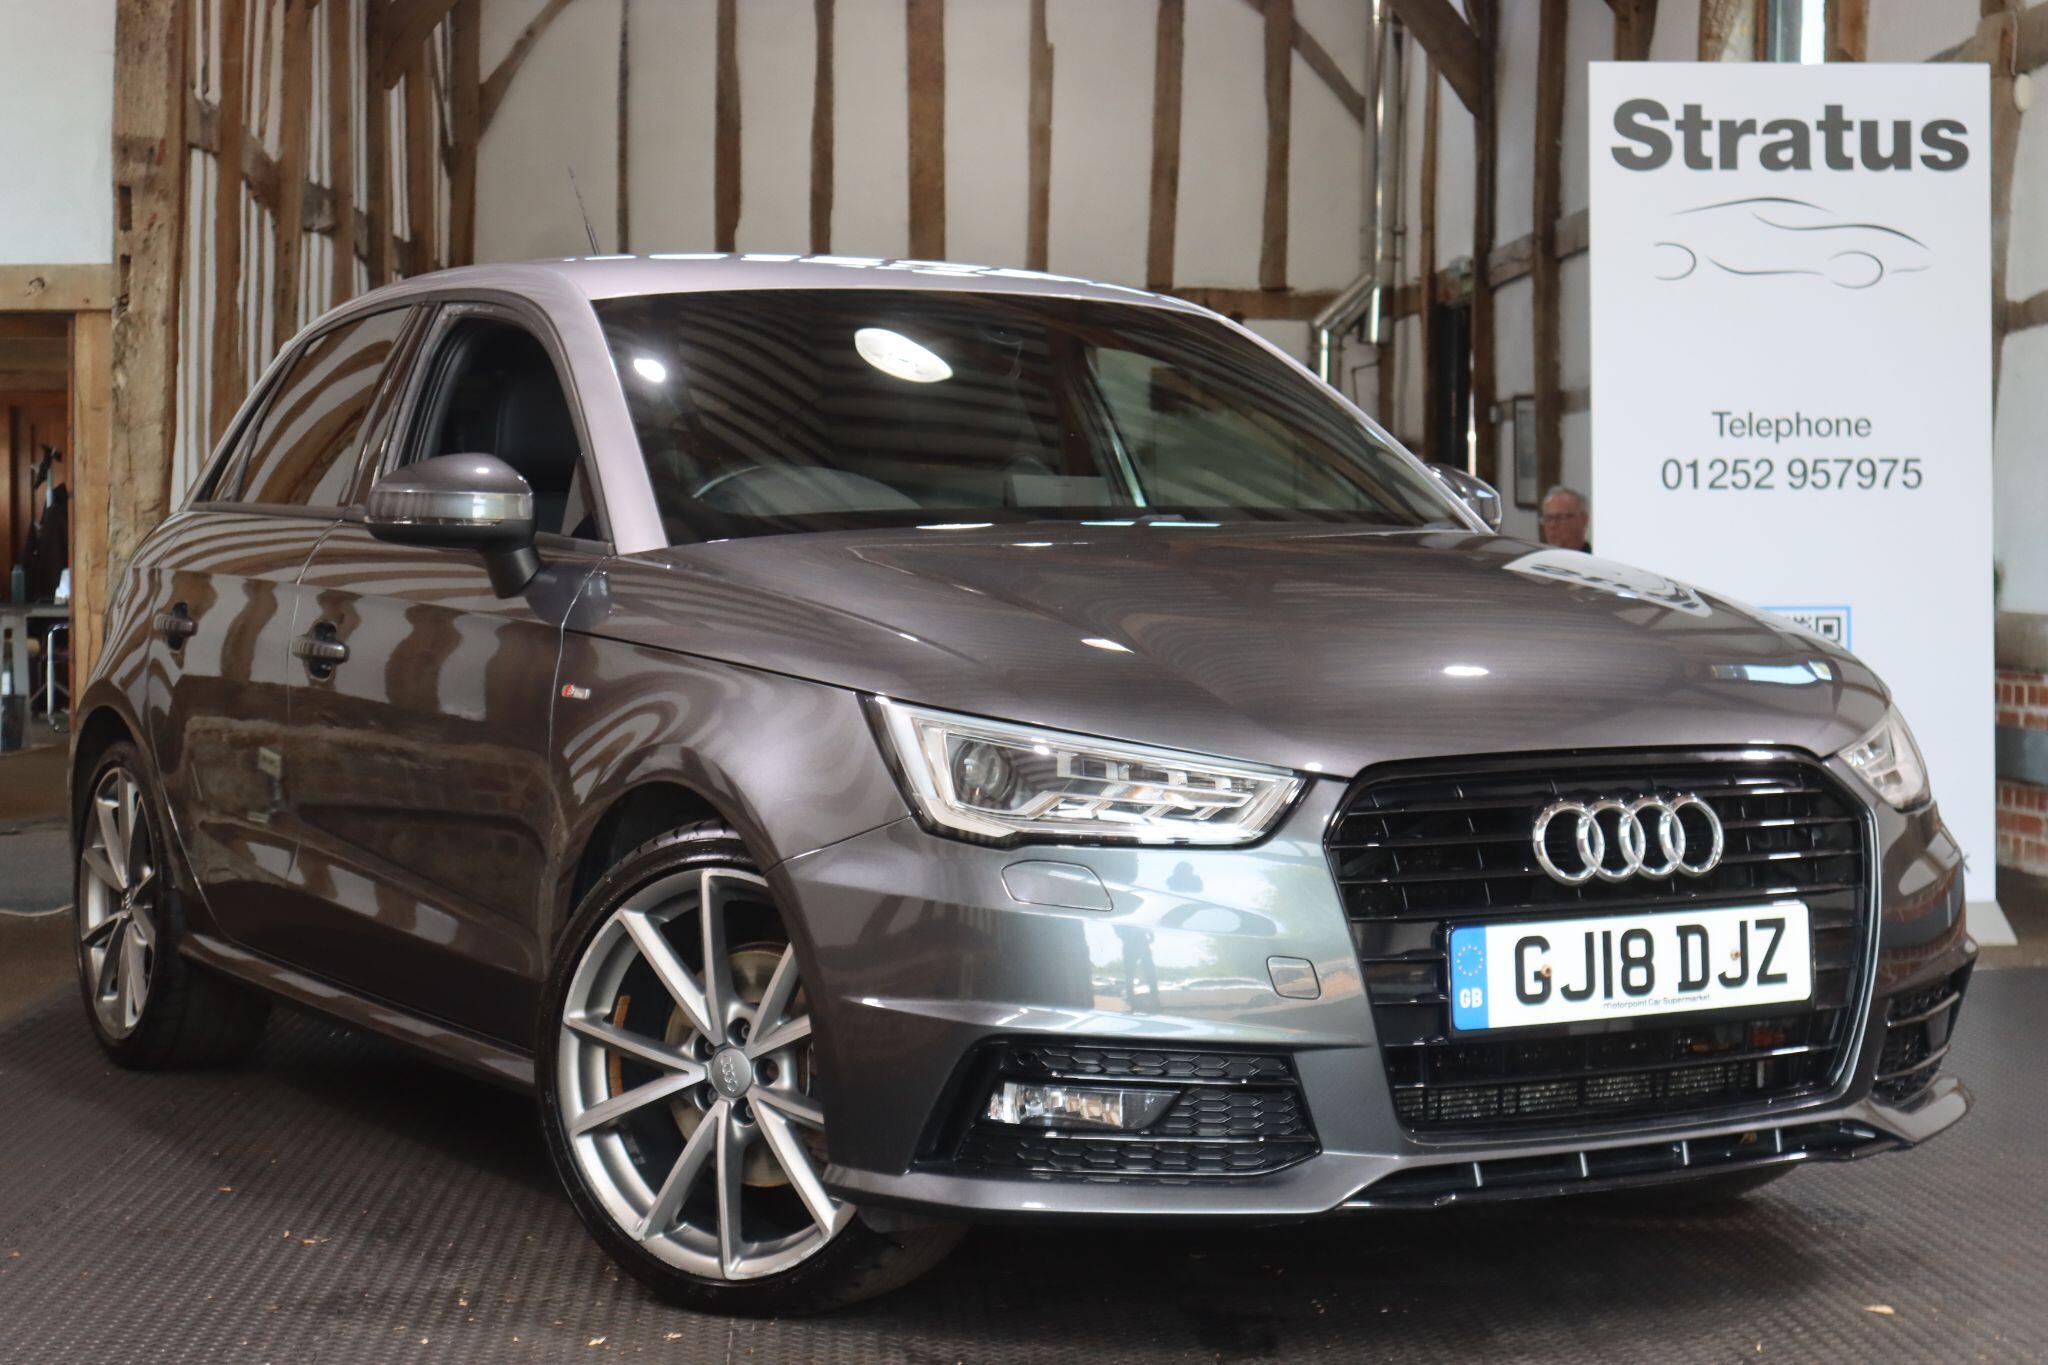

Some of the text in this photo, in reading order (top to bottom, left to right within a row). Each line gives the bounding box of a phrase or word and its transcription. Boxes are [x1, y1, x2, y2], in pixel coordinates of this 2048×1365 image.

[1610, 98, 1970, 172] Stratus
[1711, 411, 1873, 443] Telephone
[1661, 457, 1923, 491] 01252 957975
[1514, 917, 1788, 1006] GJ18 DJZ
[1459, 987, 1483, 1009] GB
